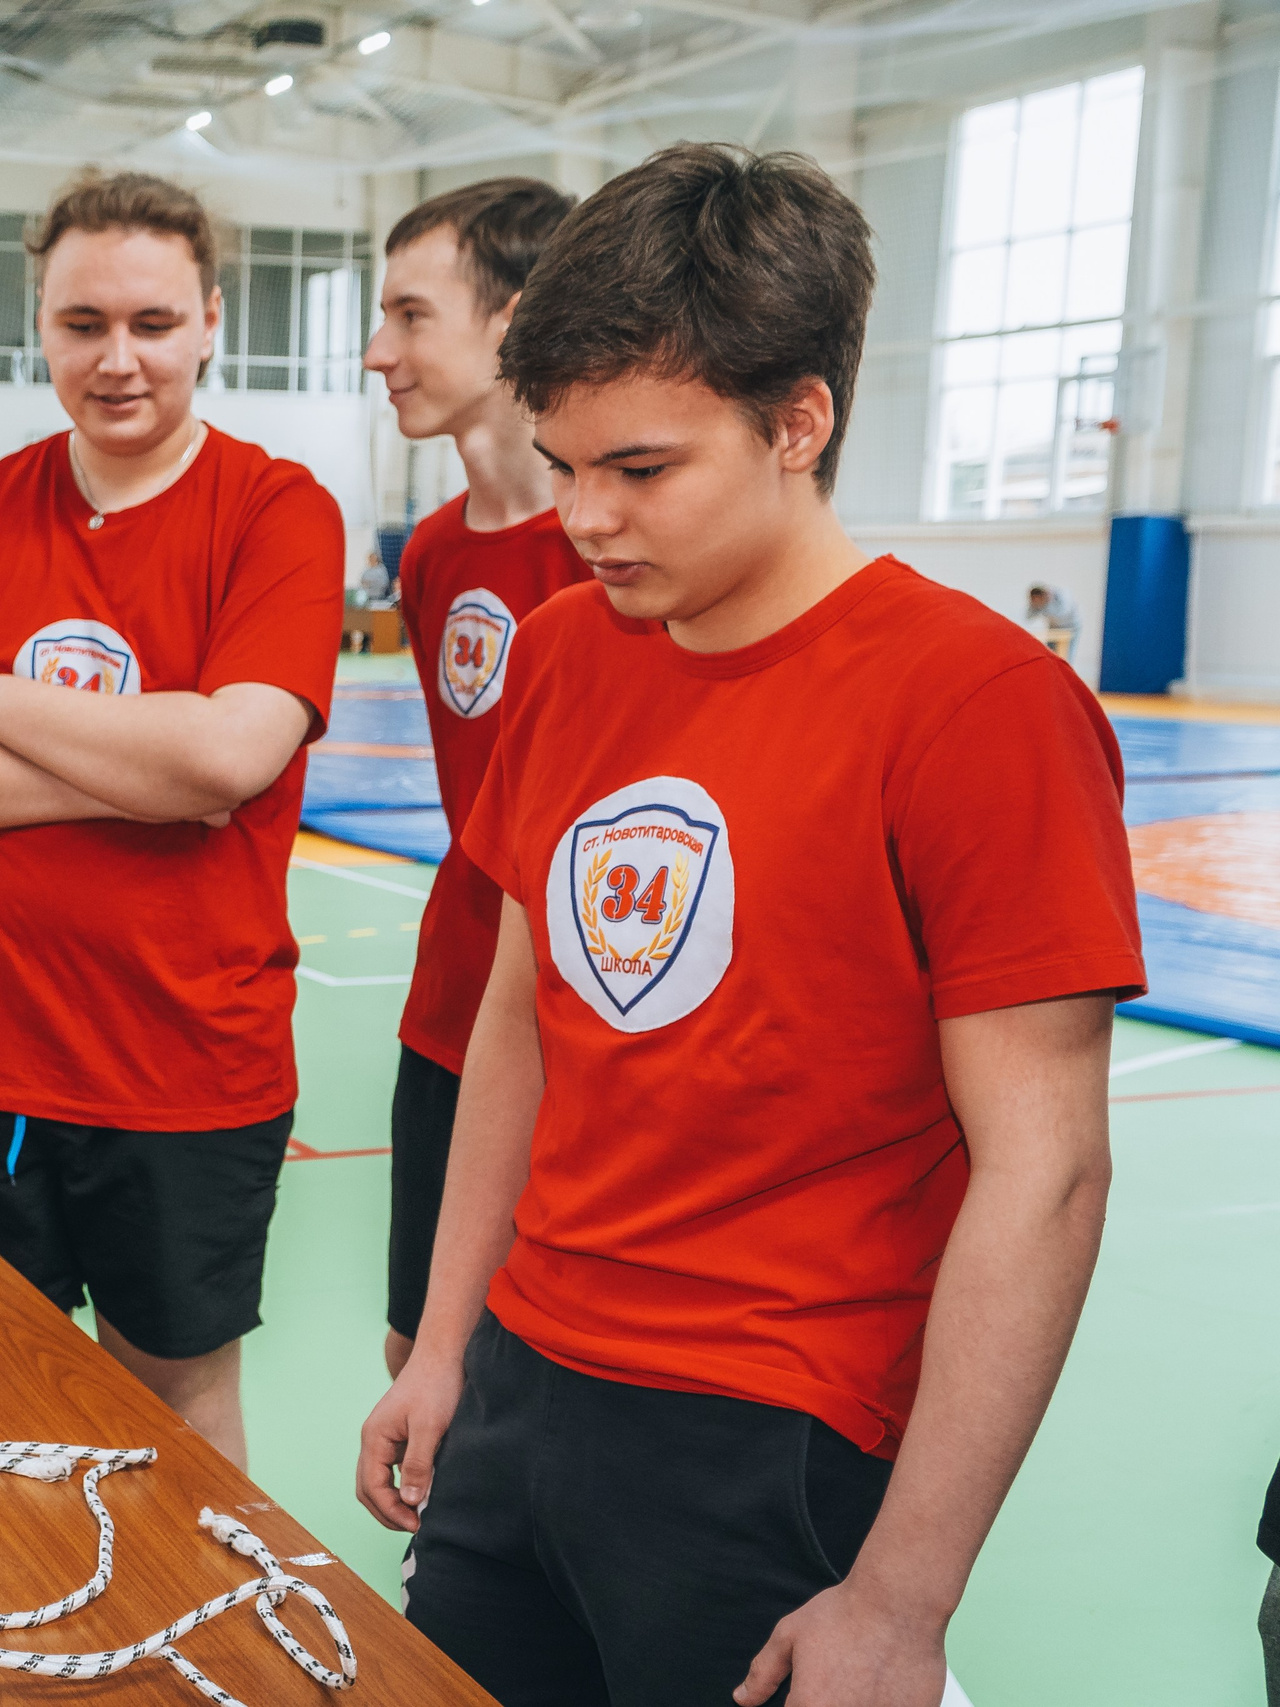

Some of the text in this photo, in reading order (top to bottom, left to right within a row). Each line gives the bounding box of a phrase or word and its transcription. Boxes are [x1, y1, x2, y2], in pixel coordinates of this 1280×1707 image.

[455, 636, 484, 668] 34
[583, 825, 703, 856] ст. Новотитаровская
[601, 864, 669, 924] 34
